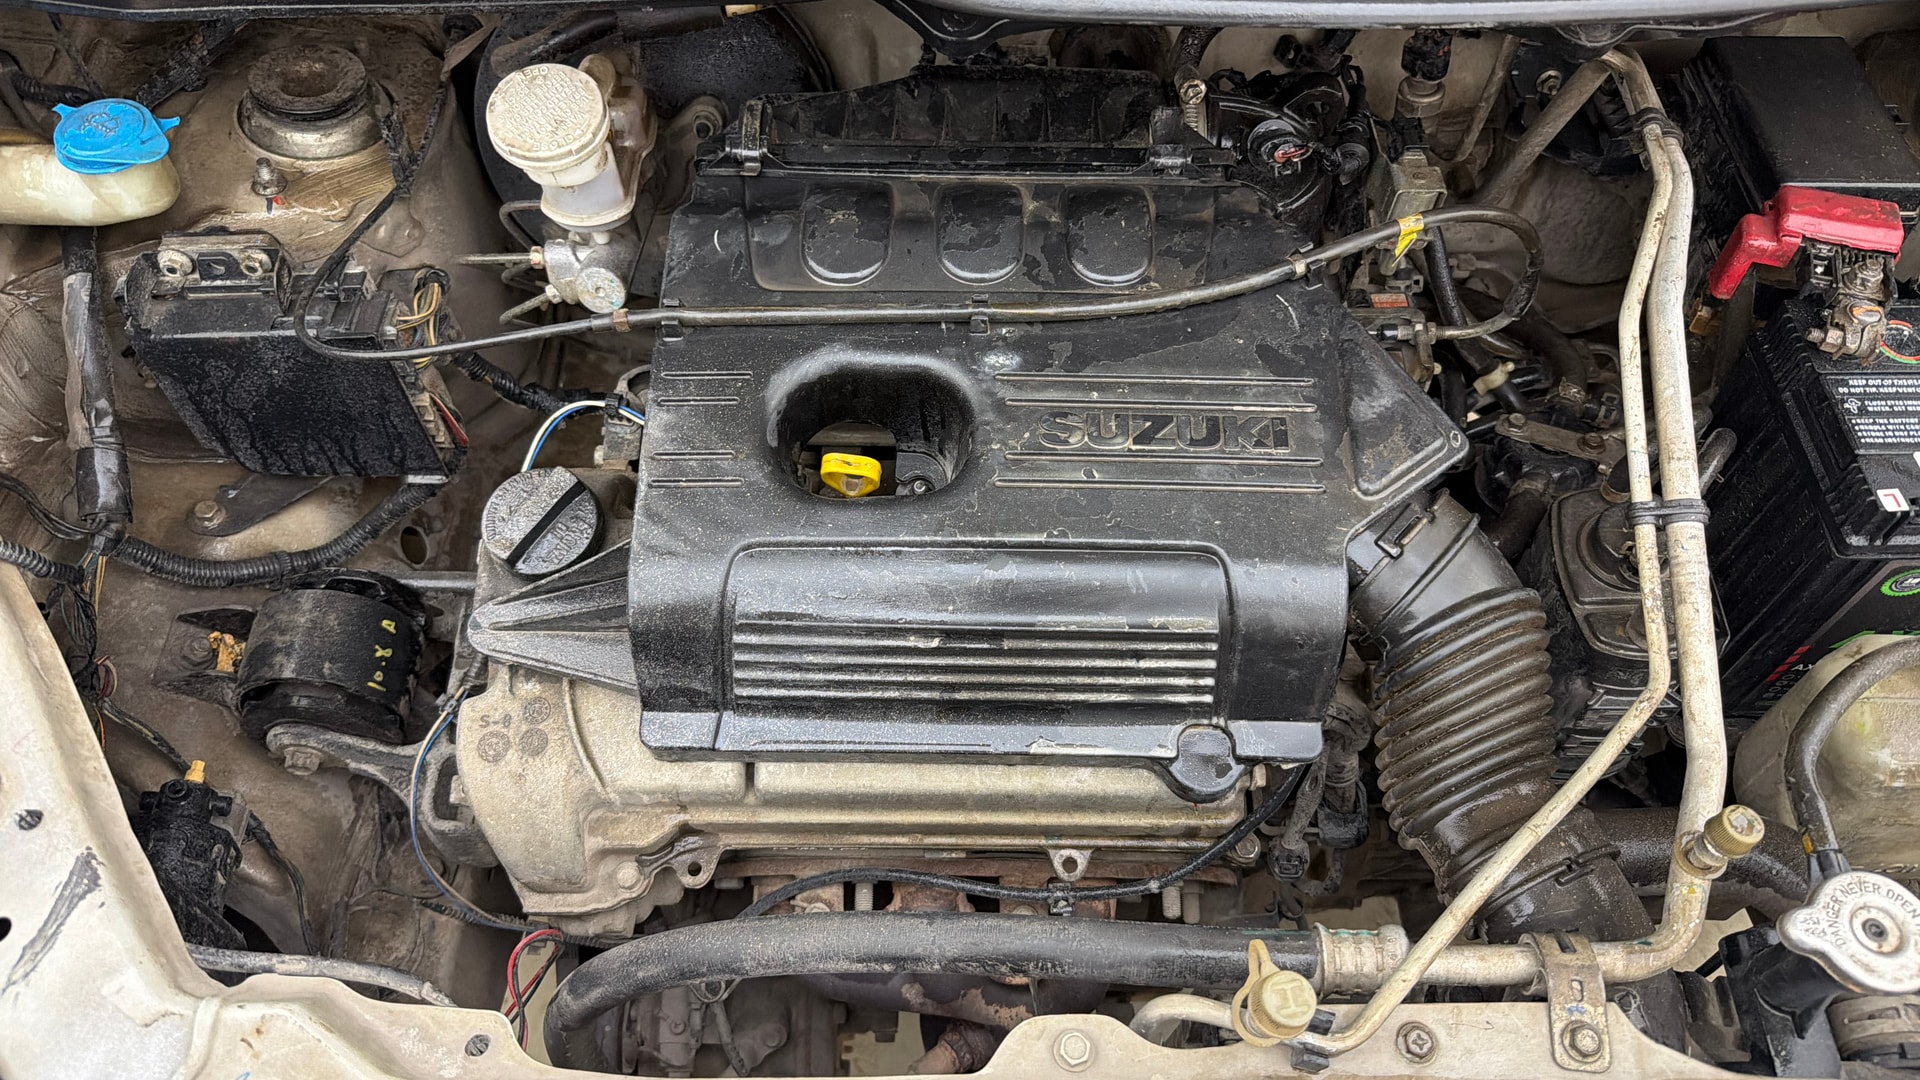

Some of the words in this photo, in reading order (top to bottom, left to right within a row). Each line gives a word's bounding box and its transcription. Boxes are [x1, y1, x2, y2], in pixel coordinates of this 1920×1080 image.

[515, 65, 549, 80] OPEN
[1039, 411, 1290, 452] SUZUKI
[1826, 895, 1846, 946] DANGER
[1840, 881, 1882, 898] NEVER
